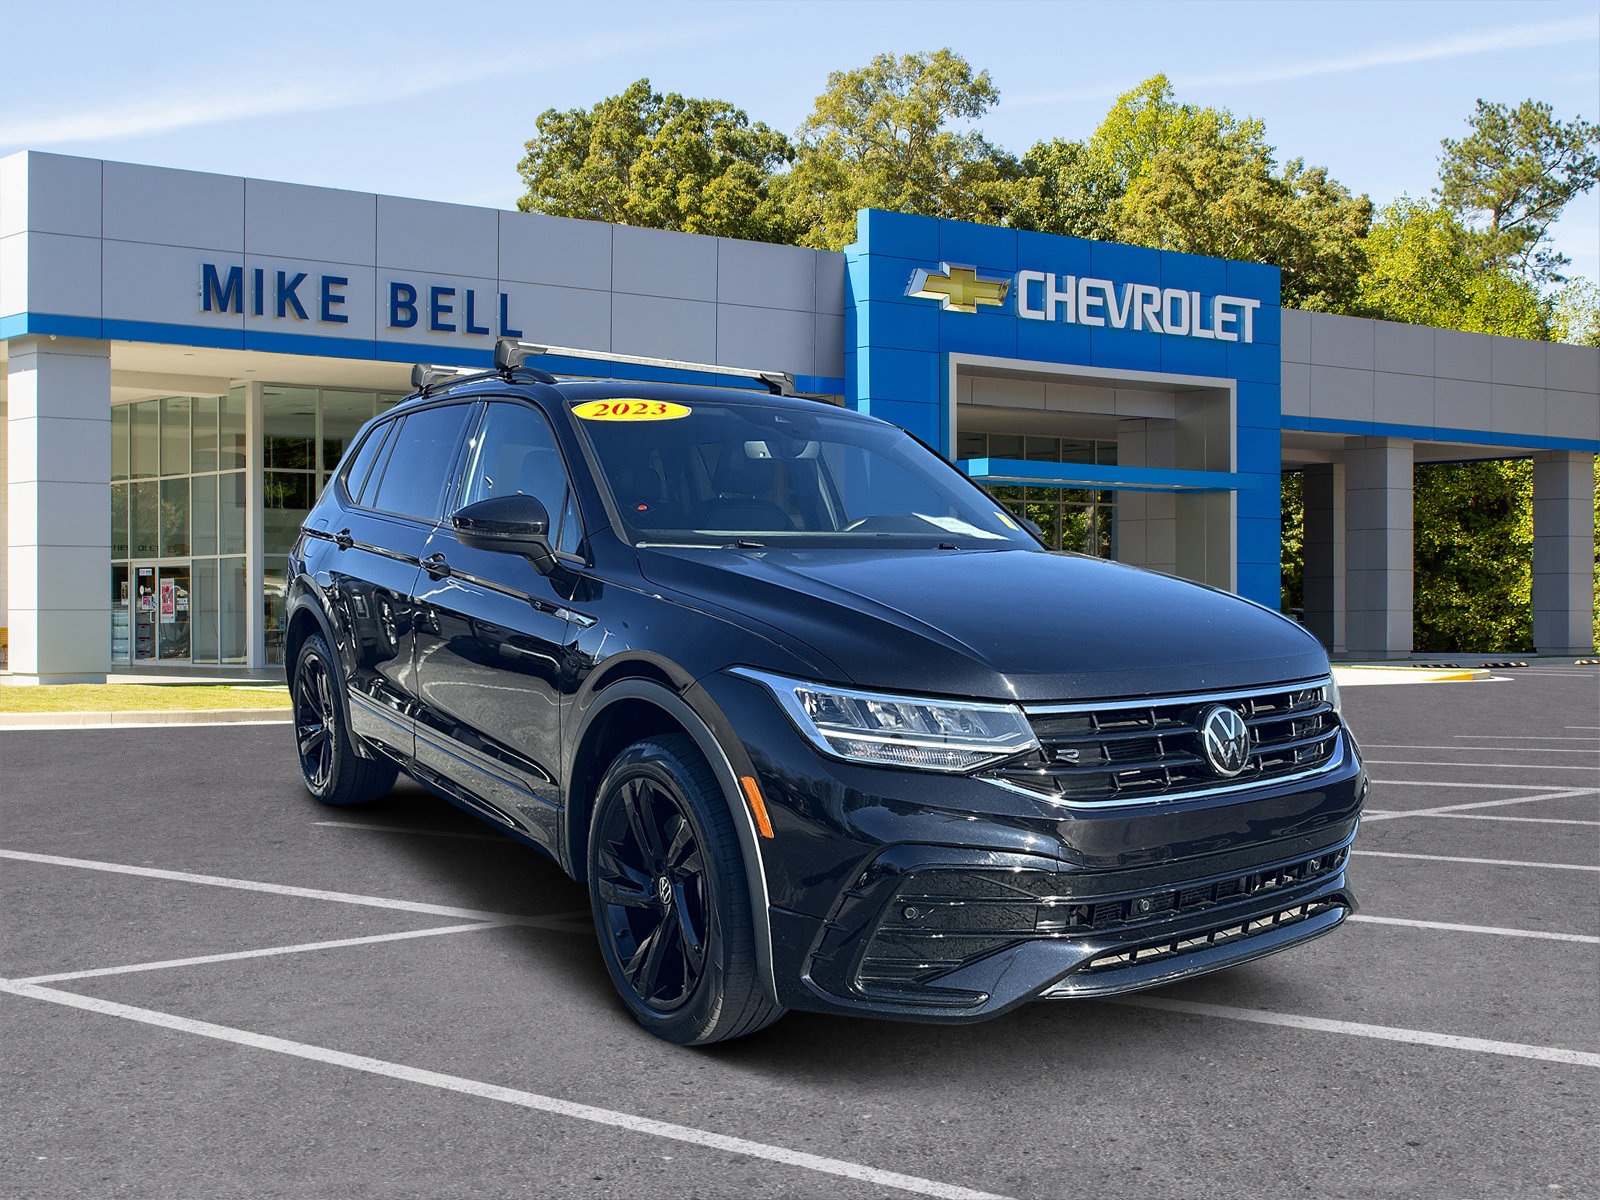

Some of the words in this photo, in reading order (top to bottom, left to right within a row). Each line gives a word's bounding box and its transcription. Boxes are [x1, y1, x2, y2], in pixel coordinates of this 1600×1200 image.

[200, 263, 349, 323] MIKE
[387, 281, 523, 338] BELL
[1015, 269, 1261, 344] CHEVROLET
[592, 402, 667, 417] 2023
[1203, 706, 1250, 778] VW
